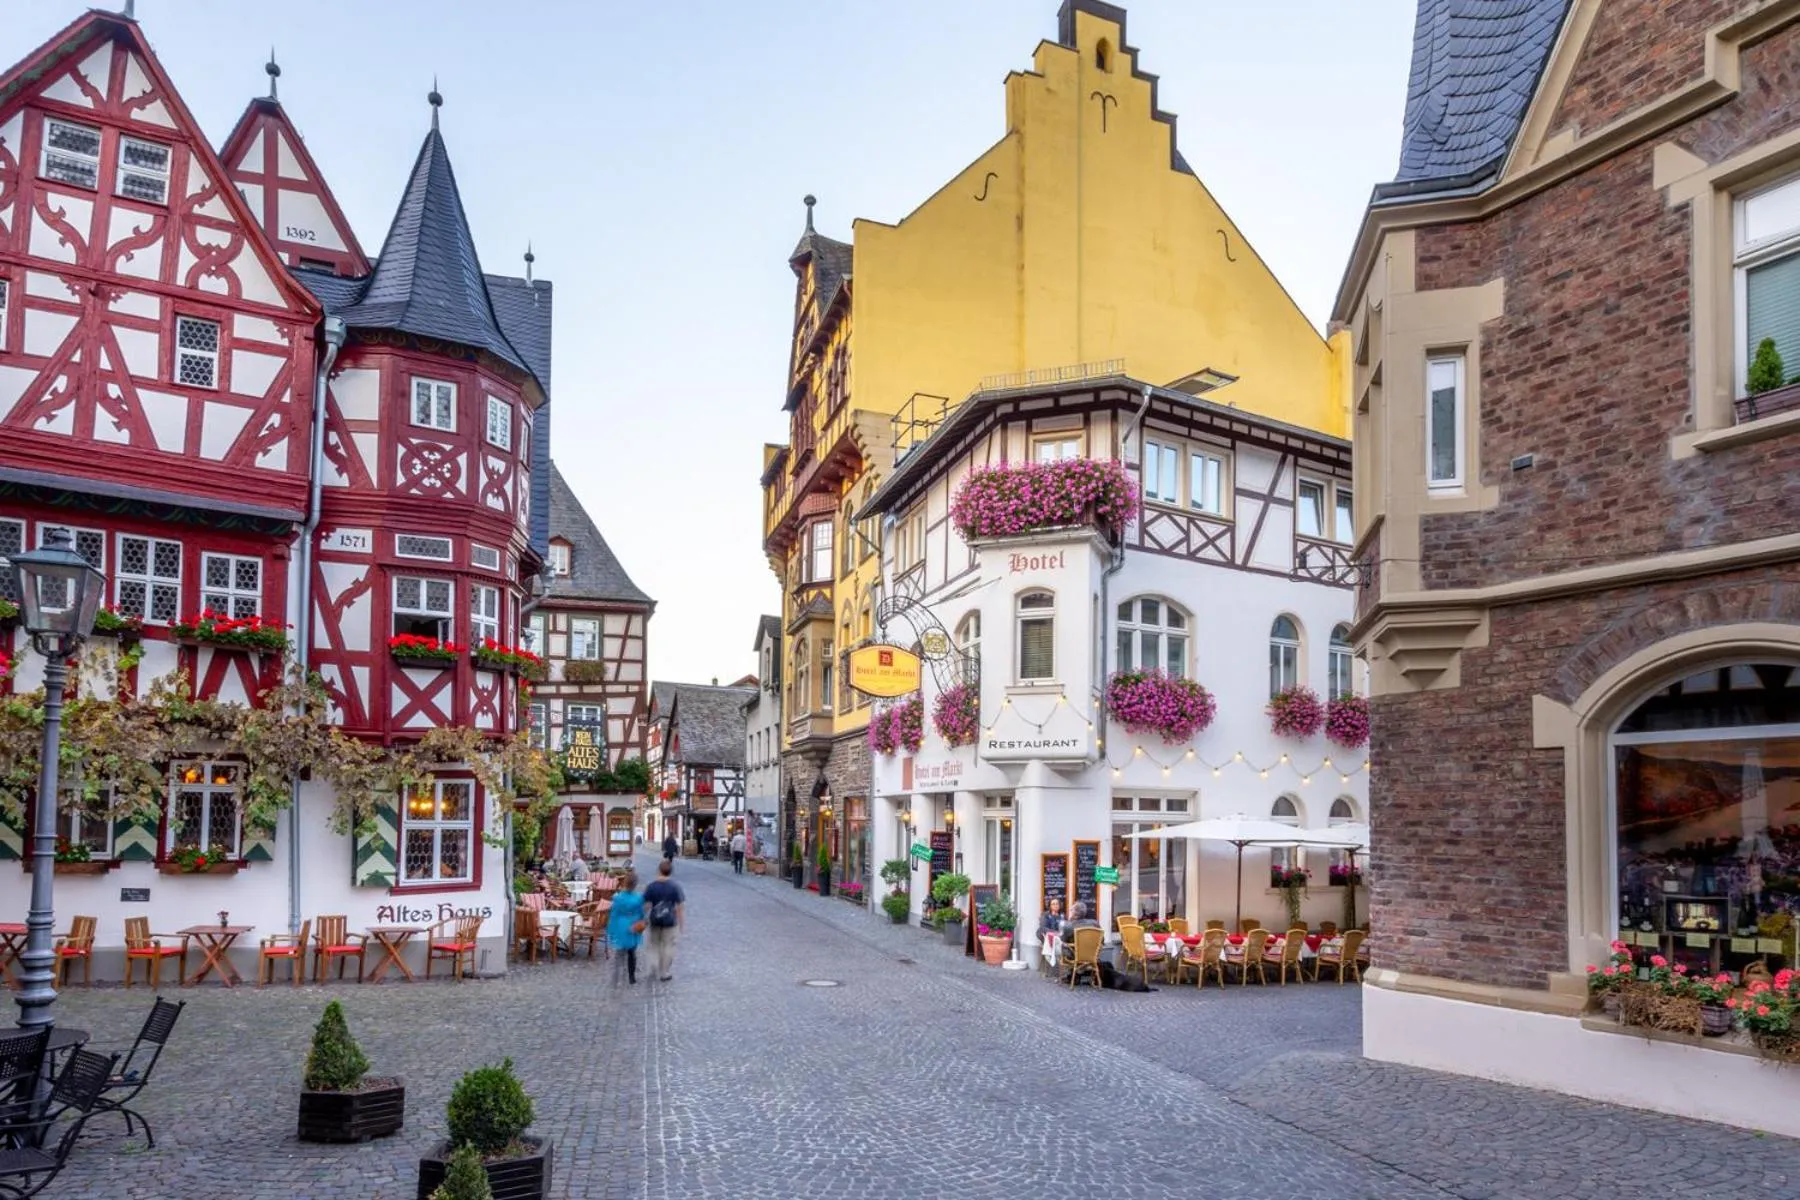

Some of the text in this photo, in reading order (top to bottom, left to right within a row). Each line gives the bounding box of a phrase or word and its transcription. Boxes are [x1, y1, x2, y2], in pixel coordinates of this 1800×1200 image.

[340, 534, 366, 548] 1571
[1008, 549, 1065, 576] Hotel
[568, 745, 600, 758] ALTES
[567, 757, 599, 770] HAUS
[376, 902, 493, 923] Altes Haus
